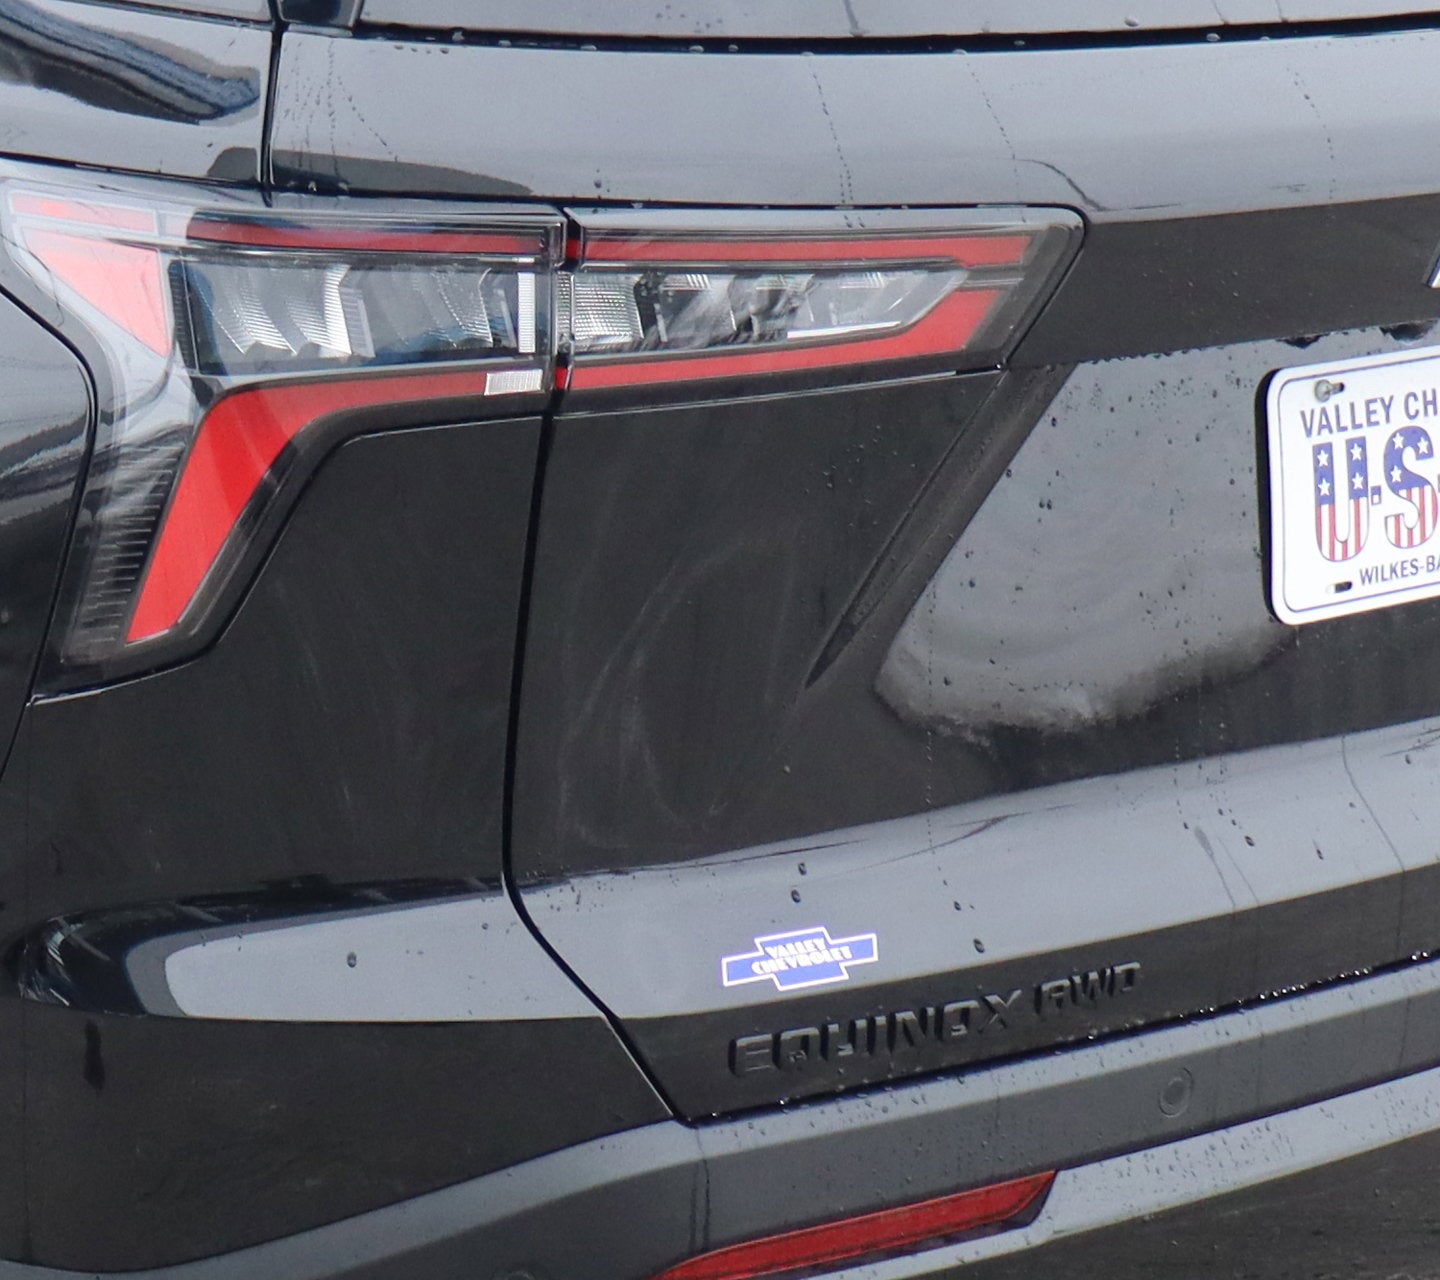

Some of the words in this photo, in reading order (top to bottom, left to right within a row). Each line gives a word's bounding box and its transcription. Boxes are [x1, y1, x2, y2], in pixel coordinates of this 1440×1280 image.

[1300, 395, 1394, 438] VALLEY
[751, 944, 853, 976] CHEVROLET
[766, 937, 826, 959] VALLEY
[728, 989, 1023, 1077] EQUINOX
[1034, 961, 1141, 1015] AWD
